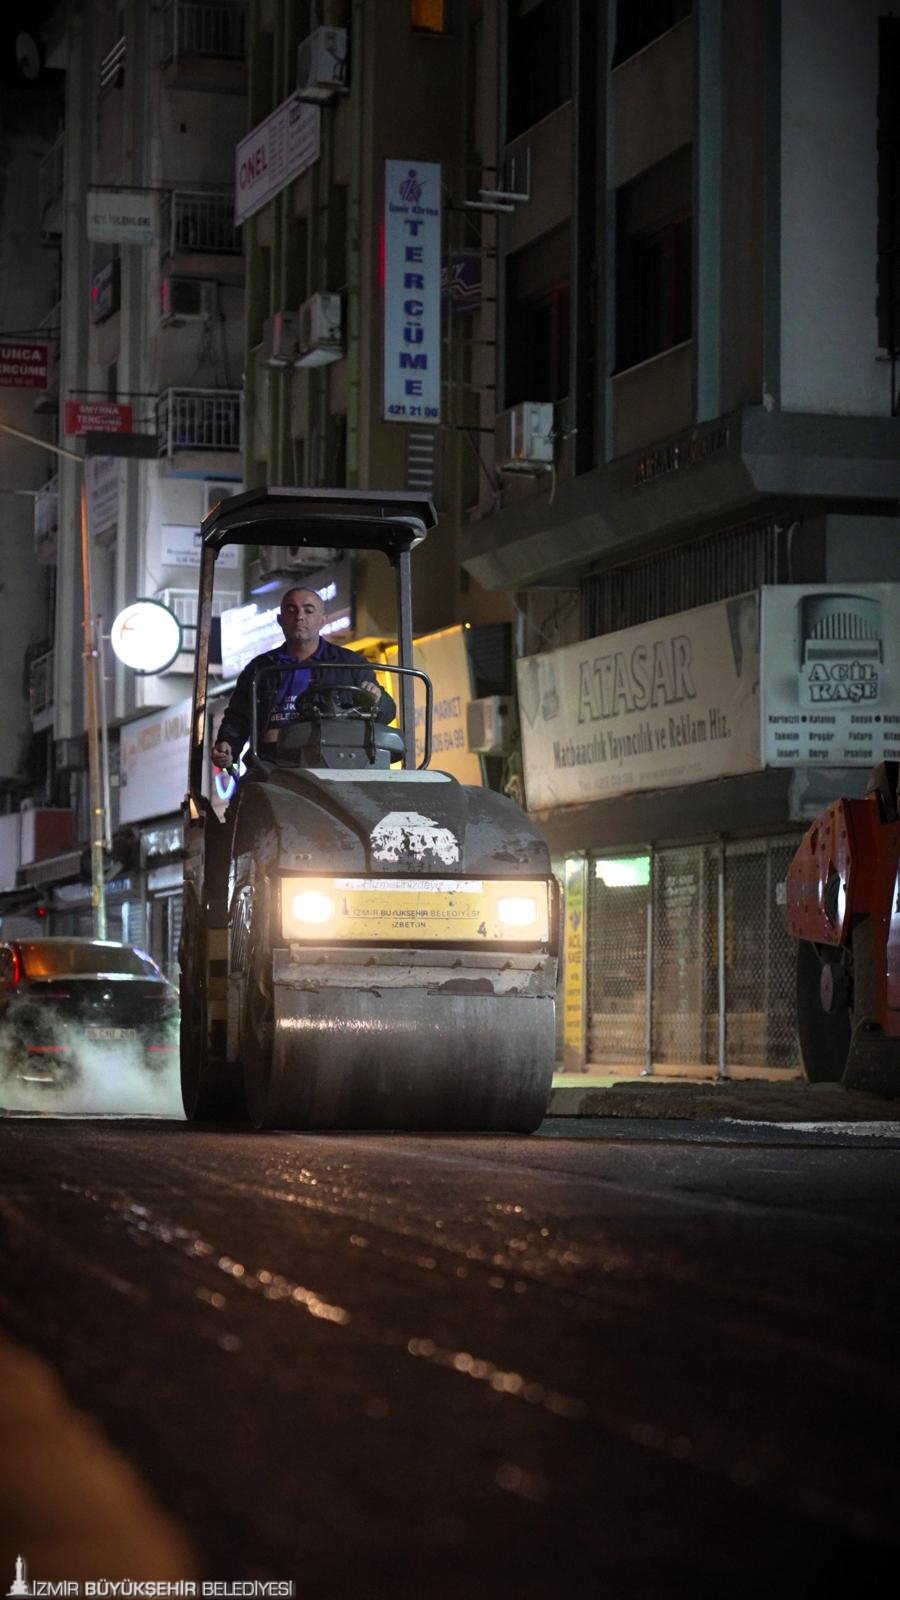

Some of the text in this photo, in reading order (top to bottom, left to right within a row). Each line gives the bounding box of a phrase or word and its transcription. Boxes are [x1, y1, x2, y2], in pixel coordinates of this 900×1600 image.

[0, 347, 41, 361] UNCA
[0, 363, 47, 377] RCÜME
[388, 405, 405, 414] 421
[409, 406, 421, 415] 21
[578, 634, 697, 724] ATASAR
[808, 660, 879, 682] ACİL
[809, 682, 878, 703] KAŞE
[655, 727, 667, 750] ve
[669, 713, 706, 748] Reklam
[708, 707, 732, 741] Hiz.
[477, 920, 488, 937] 4
